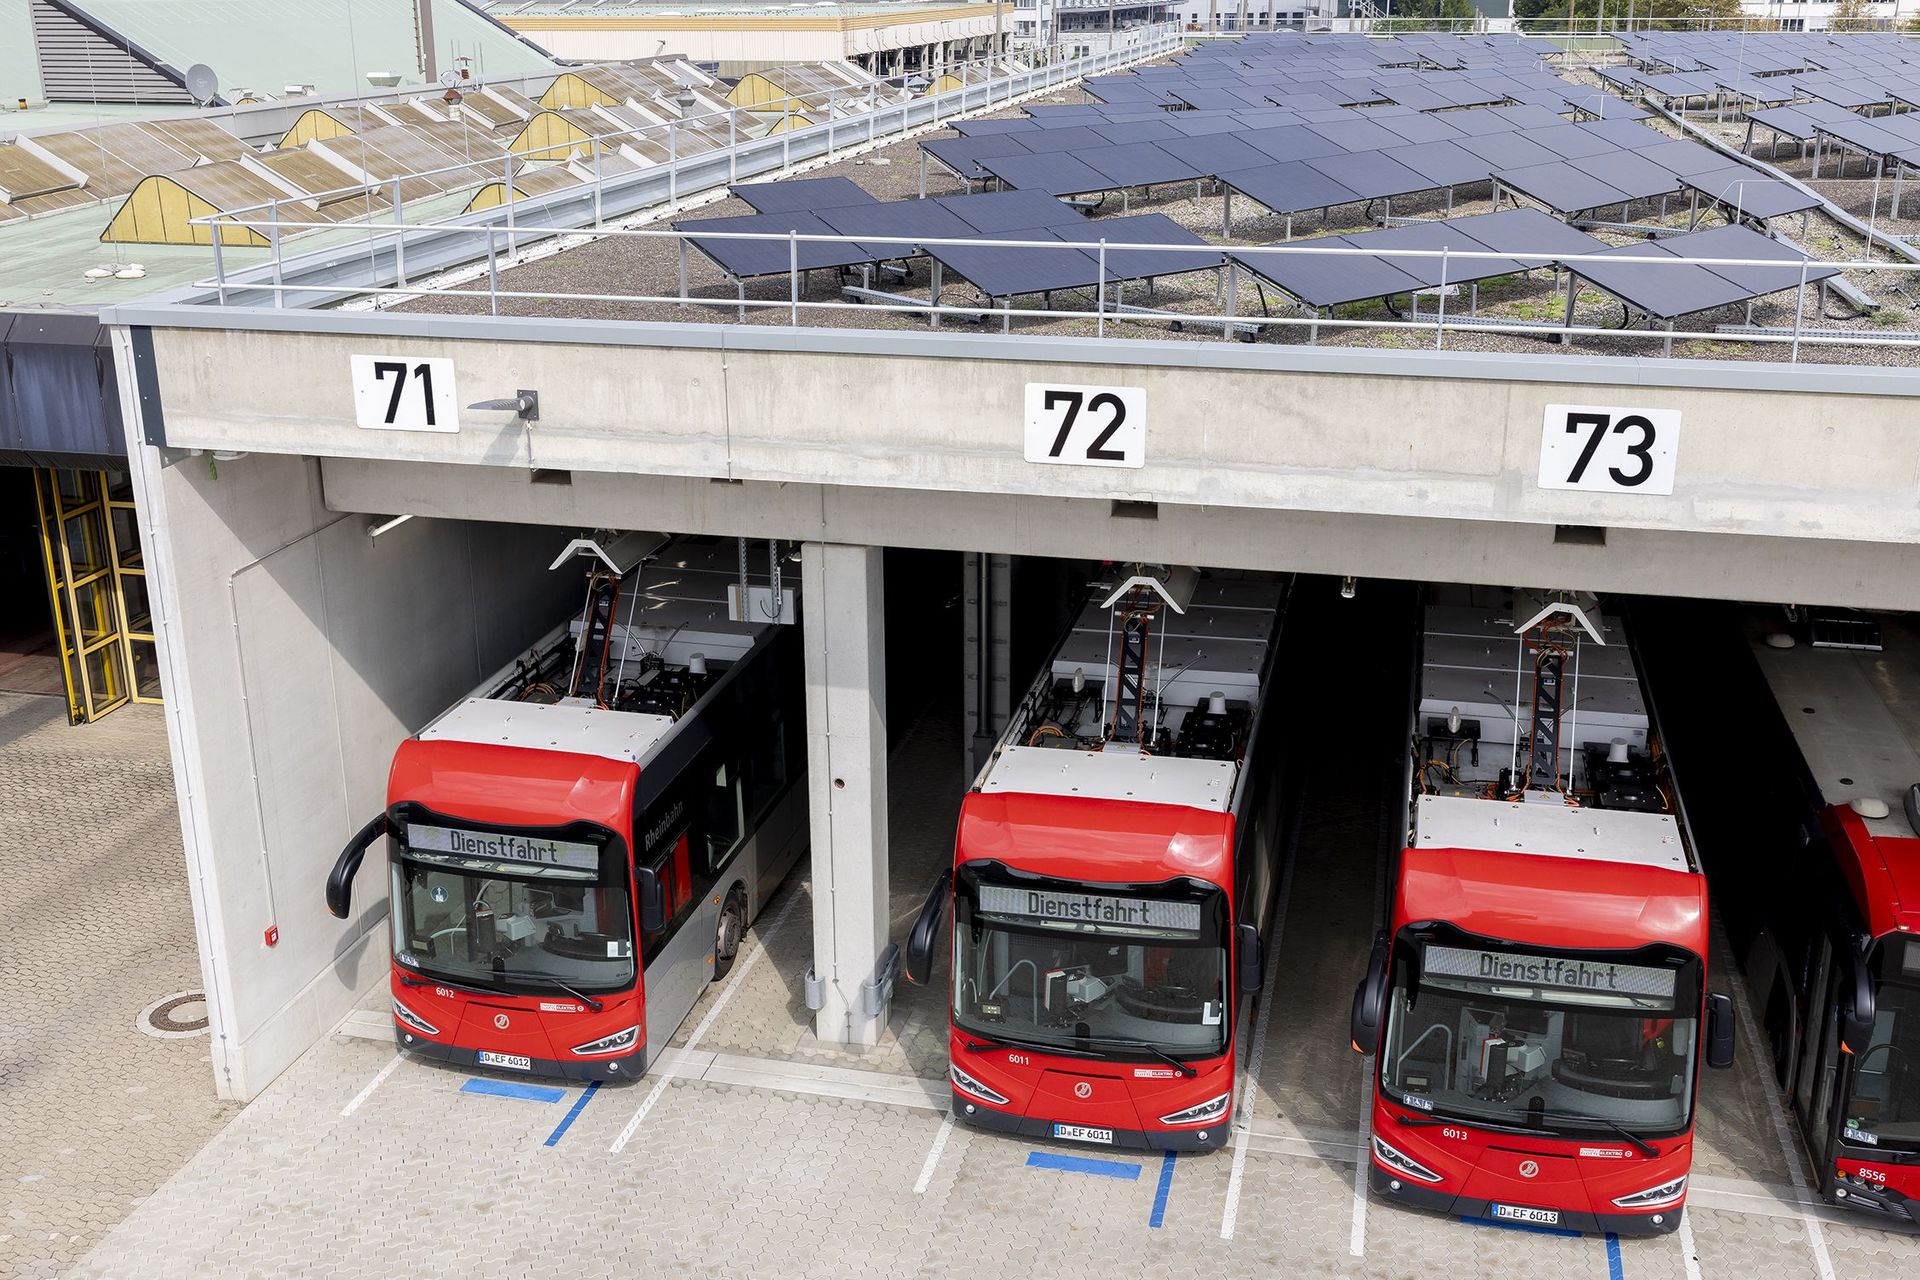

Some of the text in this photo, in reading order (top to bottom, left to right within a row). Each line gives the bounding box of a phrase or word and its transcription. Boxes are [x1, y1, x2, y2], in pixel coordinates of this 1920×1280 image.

[374, 361, 436, 426] 71
[1044, 390, 1127, 462] 72
[1565, 412, 1656, 487] 73
[644, 800, 684, 852] Rheinbahn
[450, 830, 558, 863] Dienstfahrt
[1028, 891, 1150, 924] Dienstfahrt
[1479, 952, 1617, 989] Dienstfahrt
[435, 987, 455, 999] 6012
[494, 1054, 506, 1064] EF
[507, 1056, 530, 1067] 6012
[1008, 1054, 1030, 1065] 6011
[1072, 1127, 1086, 1137] EF
[1086, 1129, 1111, 1141] 6011
[1442, 1127, 1468, 1141] 6013
[1859, 1168, 1886, 1182] 8556
[1512, 1208, 1527, 1218] EF
[1529, 1210, 1557, 1223] 6013
